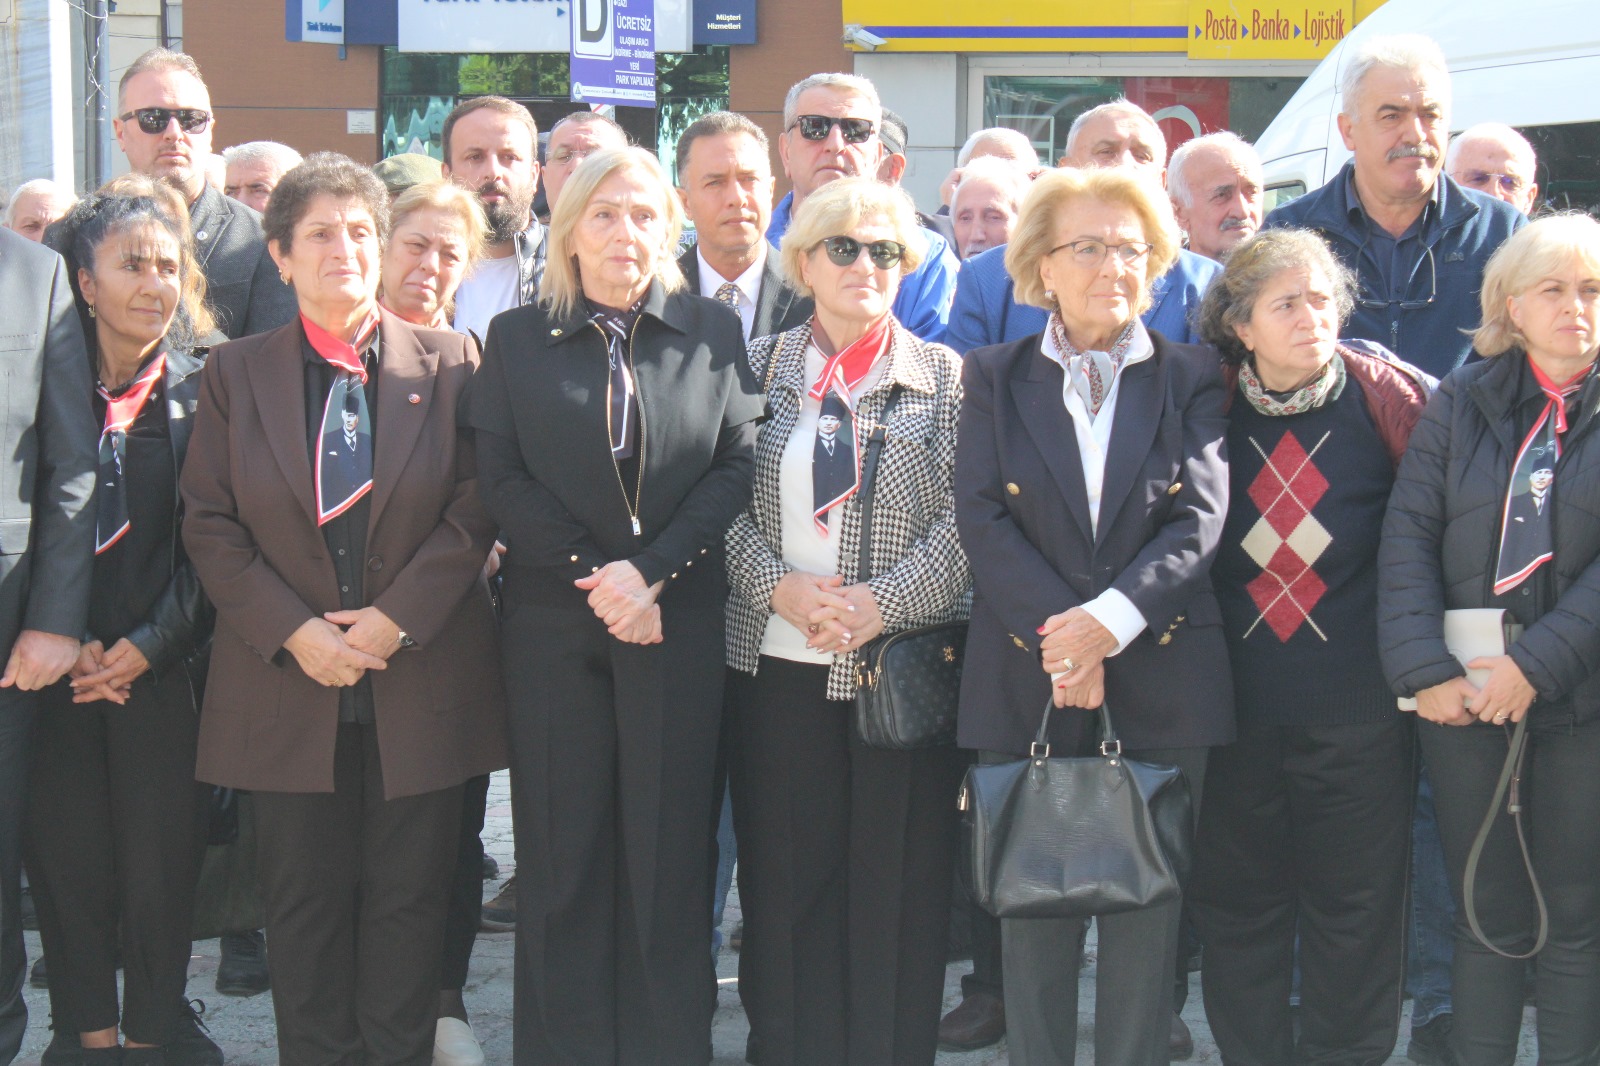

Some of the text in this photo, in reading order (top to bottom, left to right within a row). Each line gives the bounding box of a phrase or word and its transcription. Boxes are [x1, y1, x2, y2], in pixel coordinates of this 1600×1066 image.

[580, 0, 608, 43] D
[616, 13, 652, 32] ÜCRETSİZ
[716, 14, 741, 22] Müşteri
[1205, 9, 1345, 47] Posta Banka Lojistik
[615, 74, 654, 87] PARK YAPILMAZ
